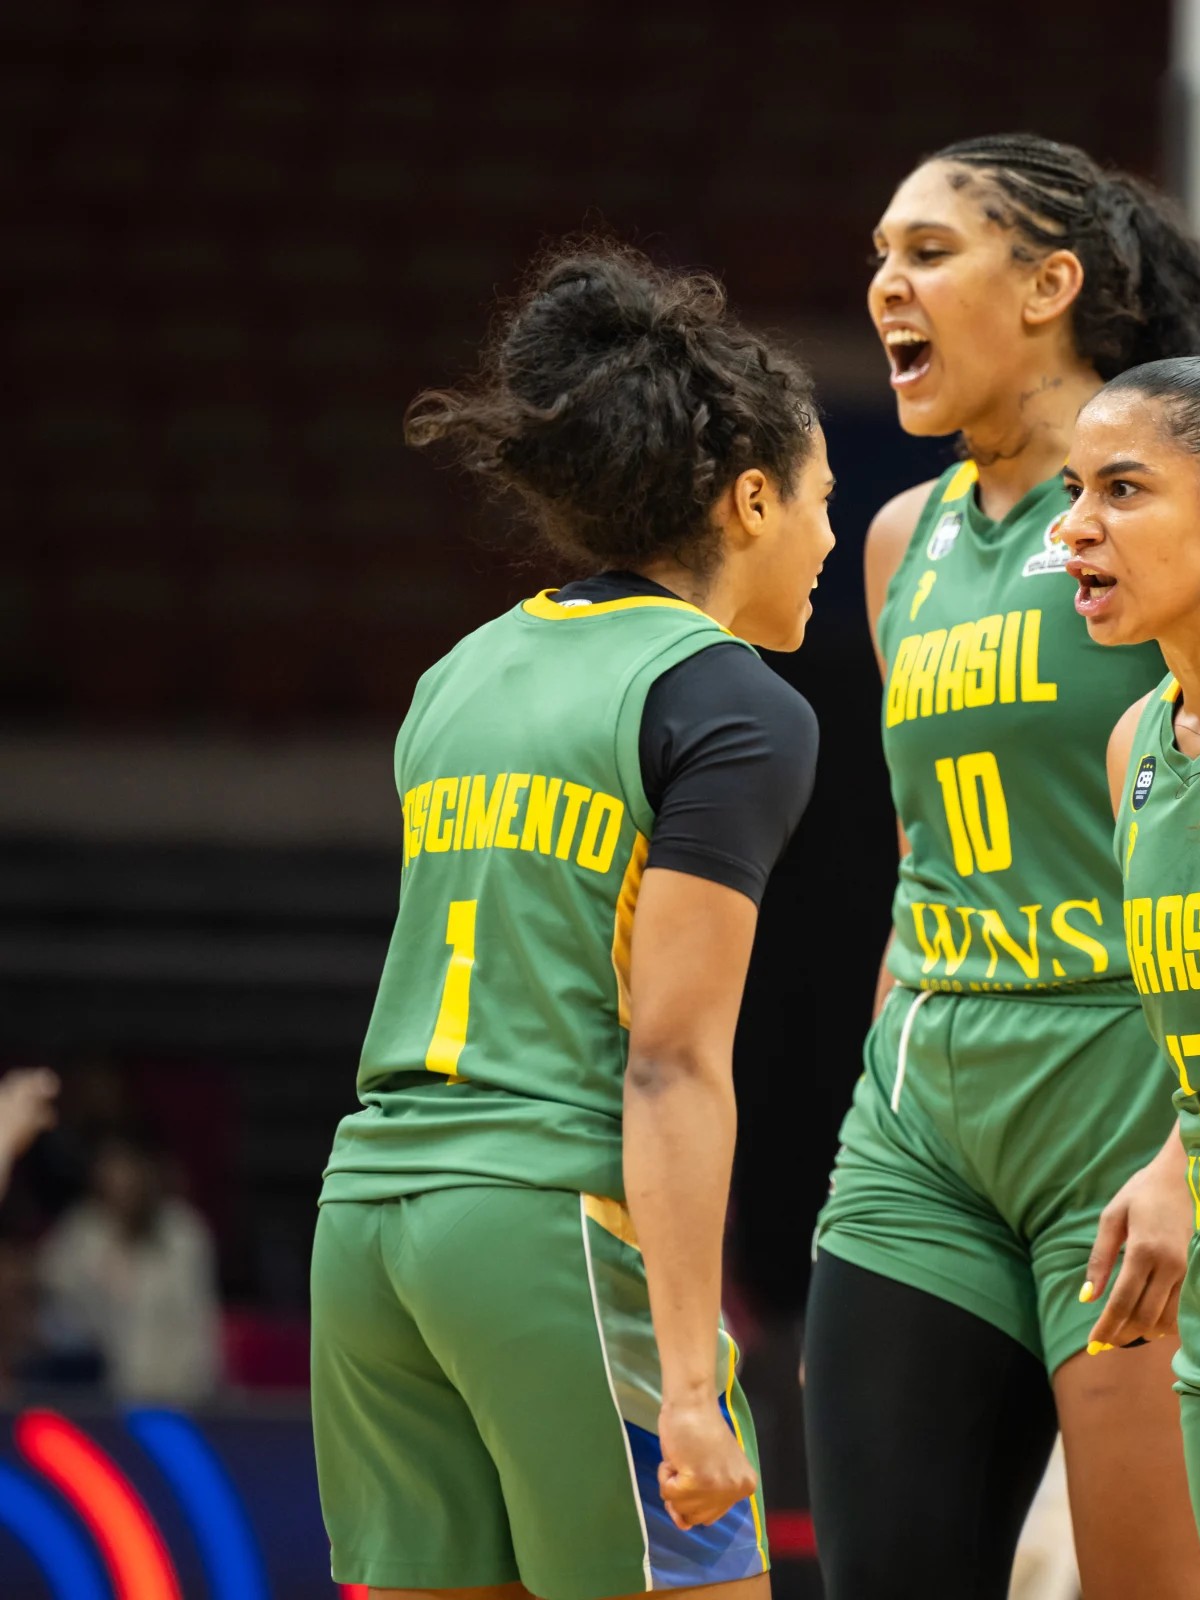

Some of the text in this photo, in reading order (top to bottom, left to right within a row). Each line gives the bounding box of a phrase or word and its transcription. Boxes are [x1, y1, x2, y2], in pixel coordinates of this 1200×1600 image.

[886, 609, 1057, 729] BRASIL
[935, 751, 1012, 877] 10
[425, 899, 477, 1085] 1
[910, 897, 1109, 979] WNS
